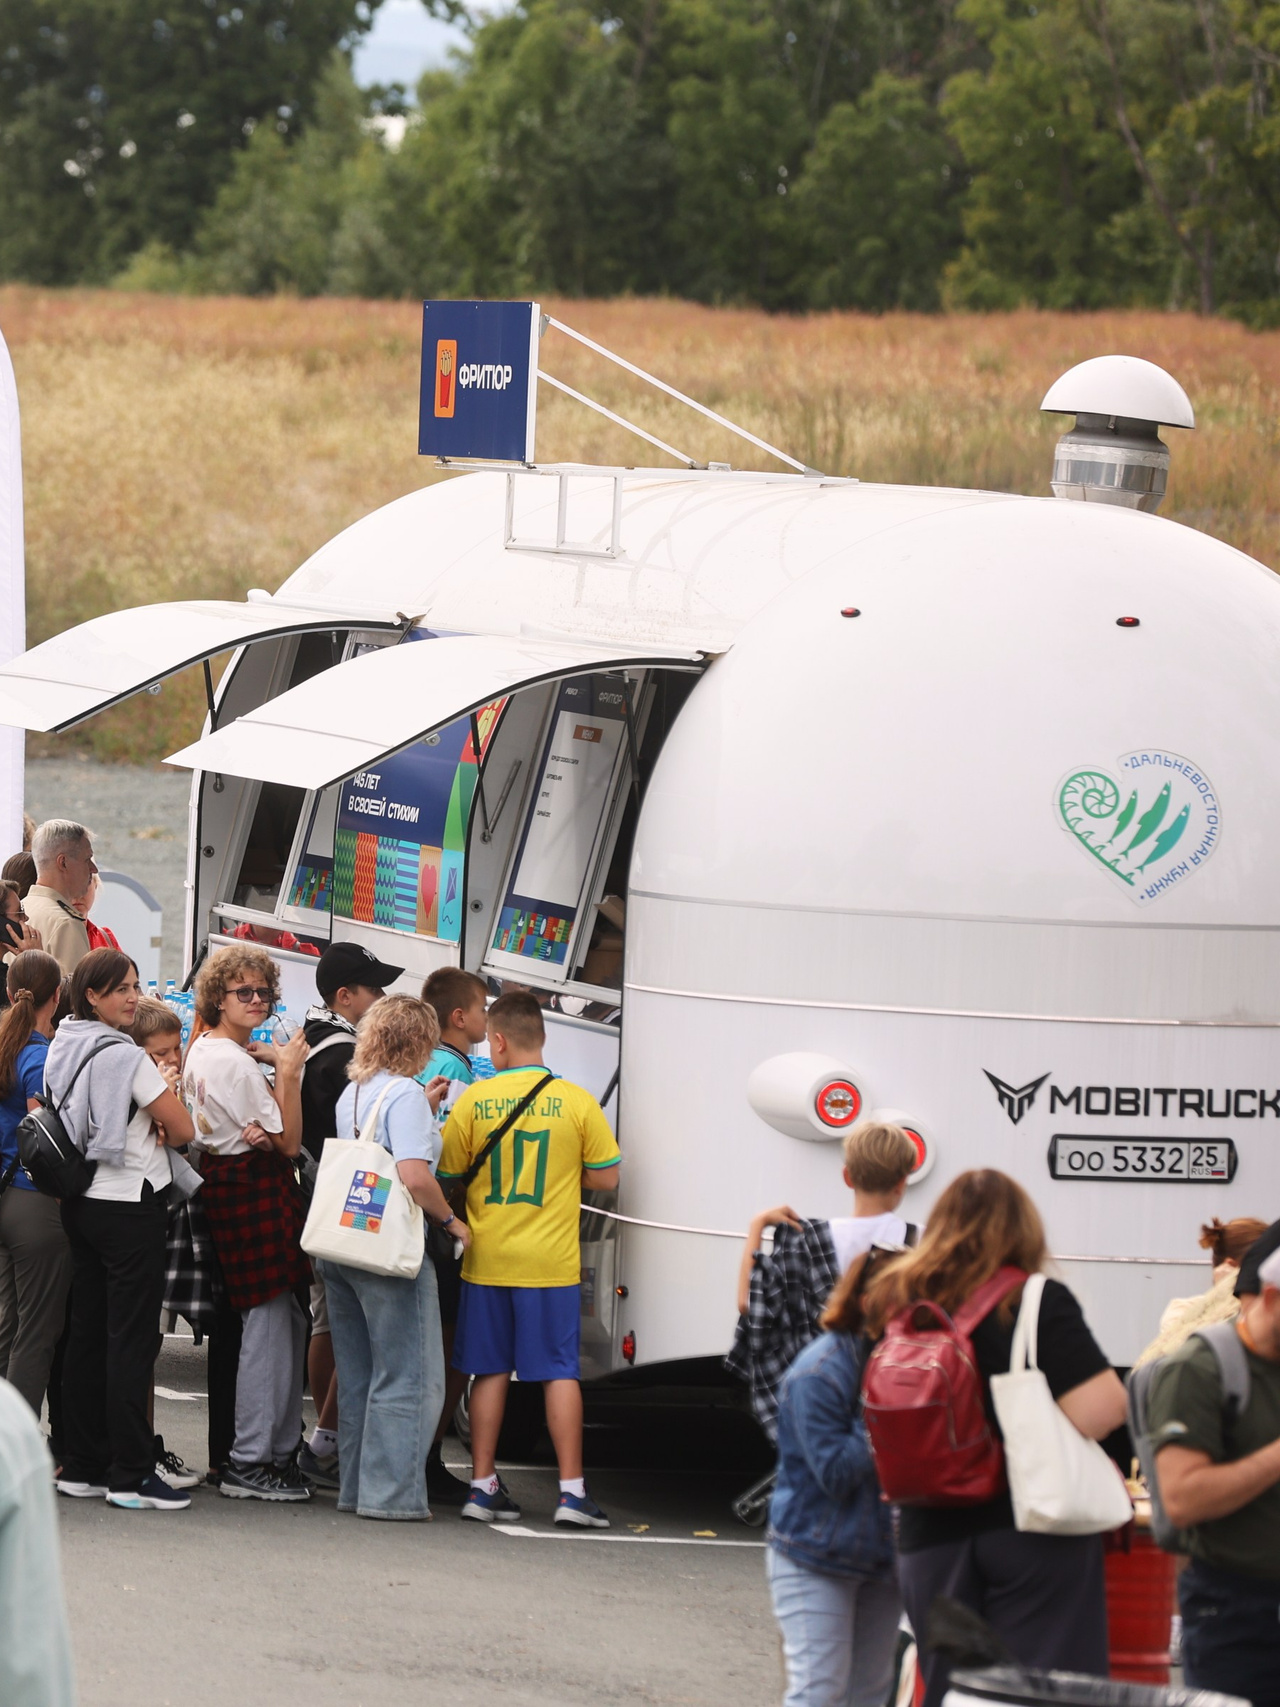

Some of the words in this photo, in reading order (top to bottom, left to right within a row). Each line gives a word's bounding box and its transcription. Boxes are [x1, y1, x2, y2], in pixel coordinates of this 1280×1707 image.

[458, 363, 512, 390] ФРИТЮР
[364, 773, 381, 790] ЛЕТ
[348, 795, 355, 811] В
[354, 796, 387, 817] СВОЕЙ
[387, 802, 420, 824] СТИХИИ
[1130, 754, 1219, 866] ДАЛЬНЕВОСТОЧНАЯ
[1145, 861, 1190, 899] КУХНЯ
[1050, 1085, 1280, 1118] MOBITRUCK
[484, 1129, 551, 1208] 10
[1113, 1146, 1183, 1174] 5332
[1192, 1146, 1218, 1167] 25
[1191, 1167, 1211, 1176] RUS
